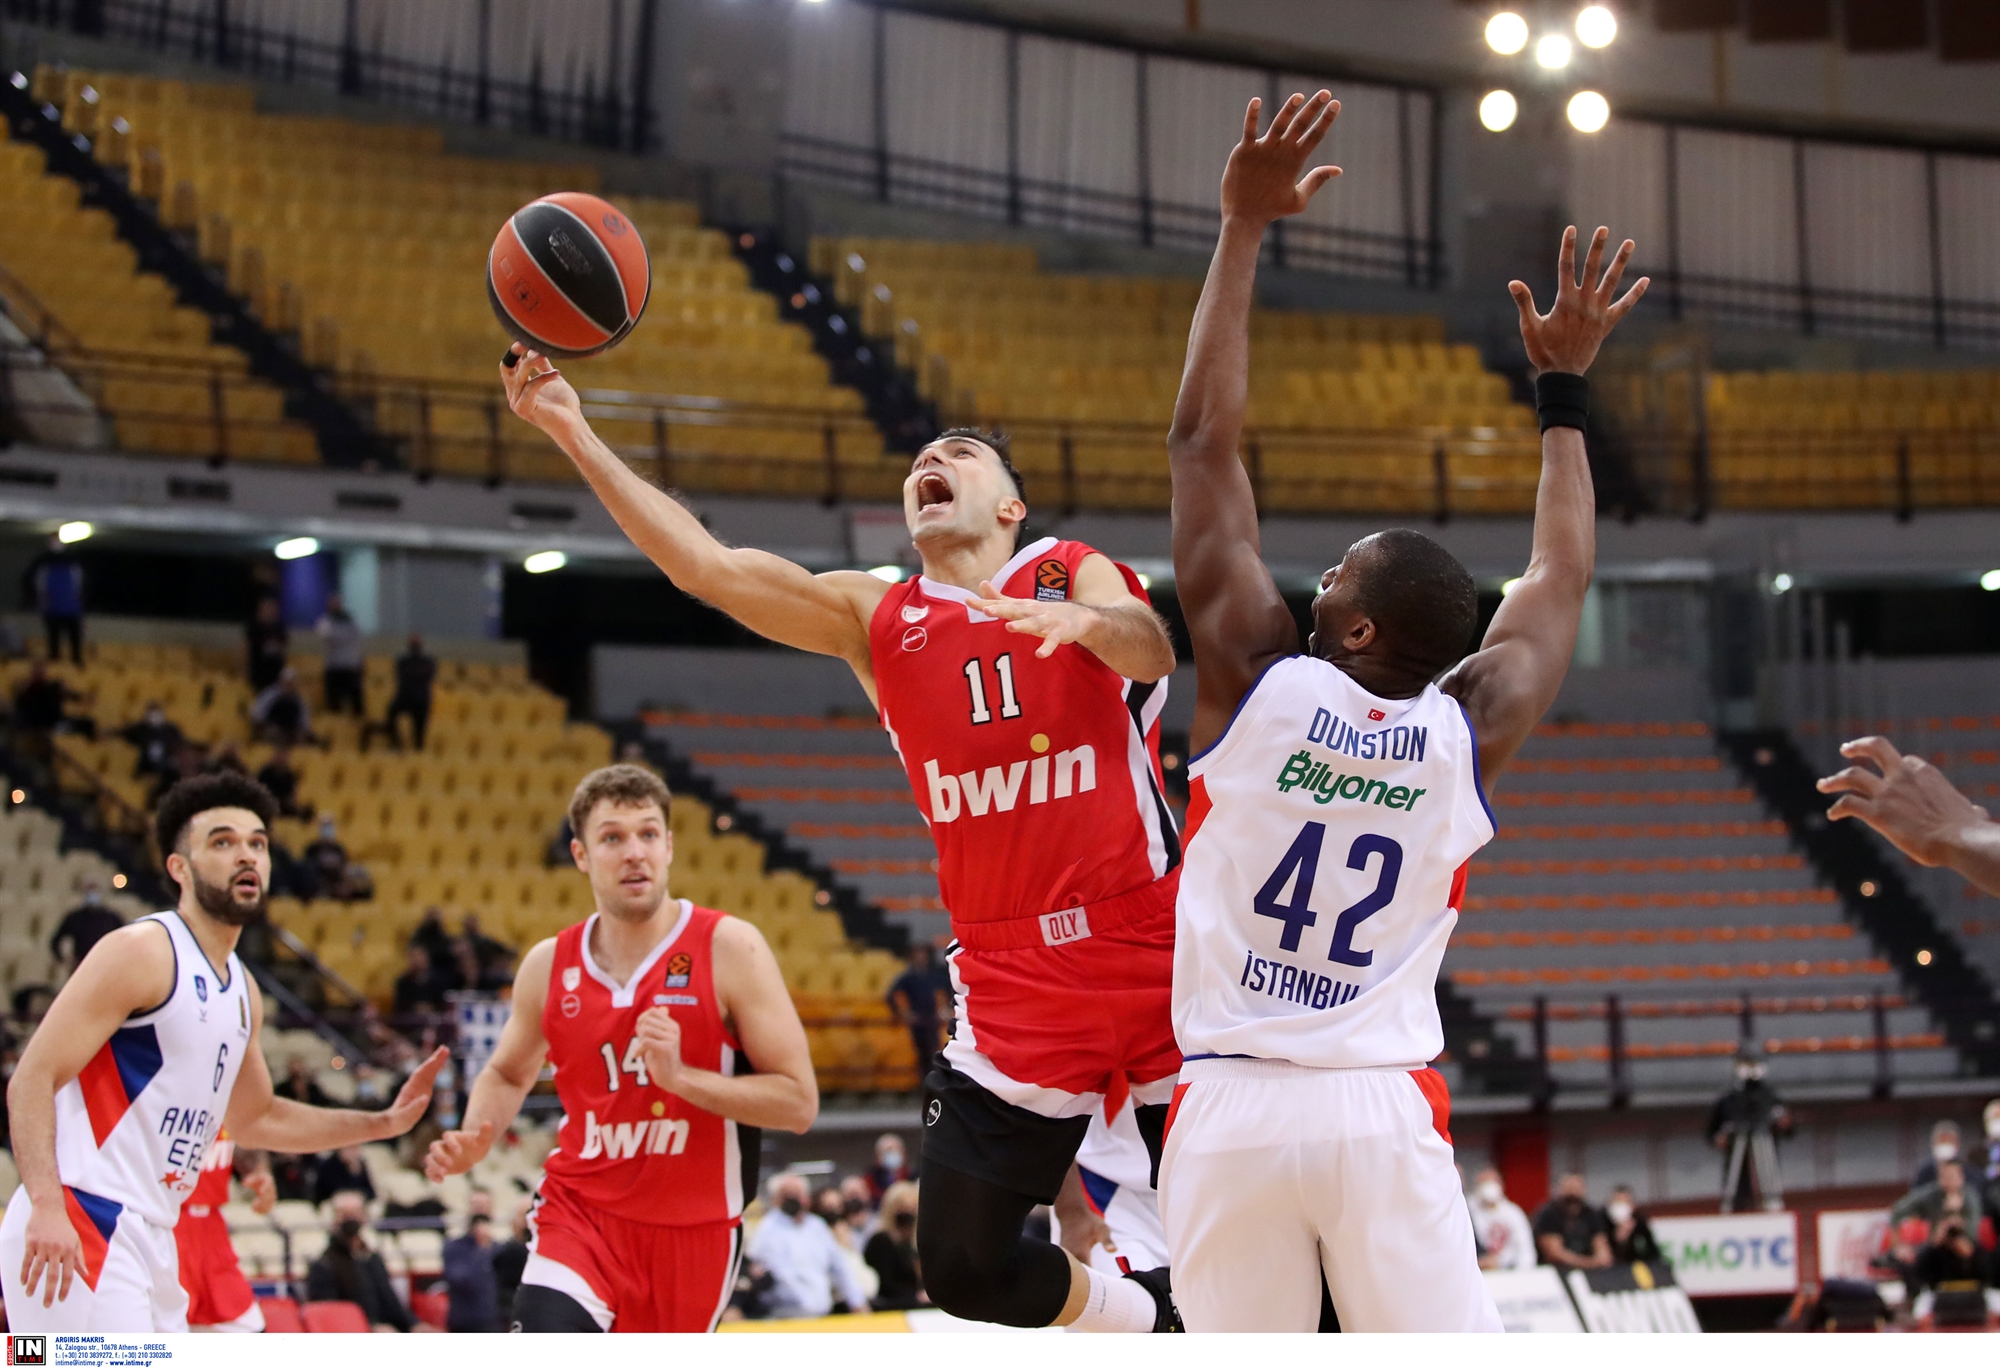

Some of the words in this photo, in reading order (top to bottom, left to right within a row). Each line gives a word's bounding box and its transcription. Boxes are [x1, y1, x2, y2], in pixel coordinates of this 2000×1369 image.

[964, 652, 1022, 726] 11
[1307, 707, 1427, 762] DUNSTON
[924, 733, 1096, 823] bwin
[1276, 750, 1426, 811] Bilyoner
[1254, 821, 1403, 967] 42
[1049, 912, 1078, 940] OLY
[213, 1043, 228, 1092] 6
[600, 1036, 649, 1092] 14
[579, 1101, 690, 1160] bwin
